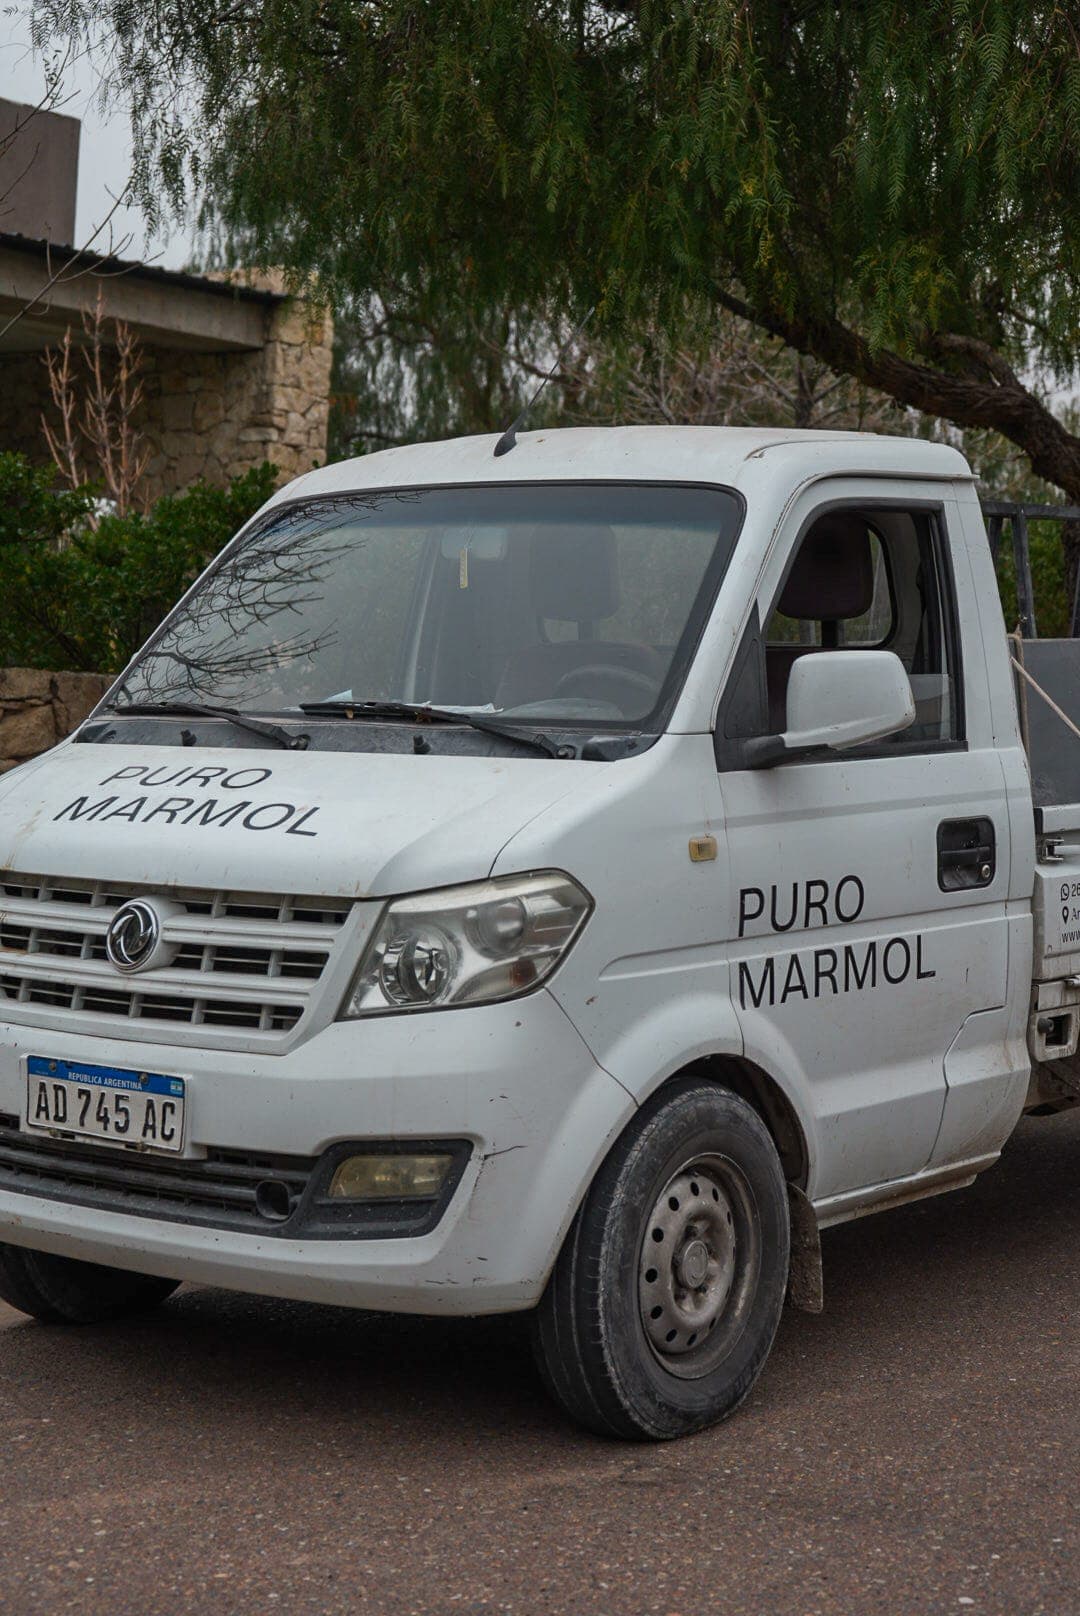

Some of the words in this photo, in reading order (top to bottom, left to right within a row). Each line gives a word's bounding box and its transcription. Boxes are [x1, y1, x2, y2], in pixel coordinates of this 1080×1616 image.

[99, 766, 272, 789] PURO
[53, 796, 320, 836] MARMOL
[739, 875, 864, 937] PURO
[738, 935, 936, 1010] MARMOL
[103, 1078, 143, 1091] ARGENTINA
[35, 1081, 67, 1123] AD
[77, 1088, 129, 1133] 745
[142, 1099, 176, 1141] AC
